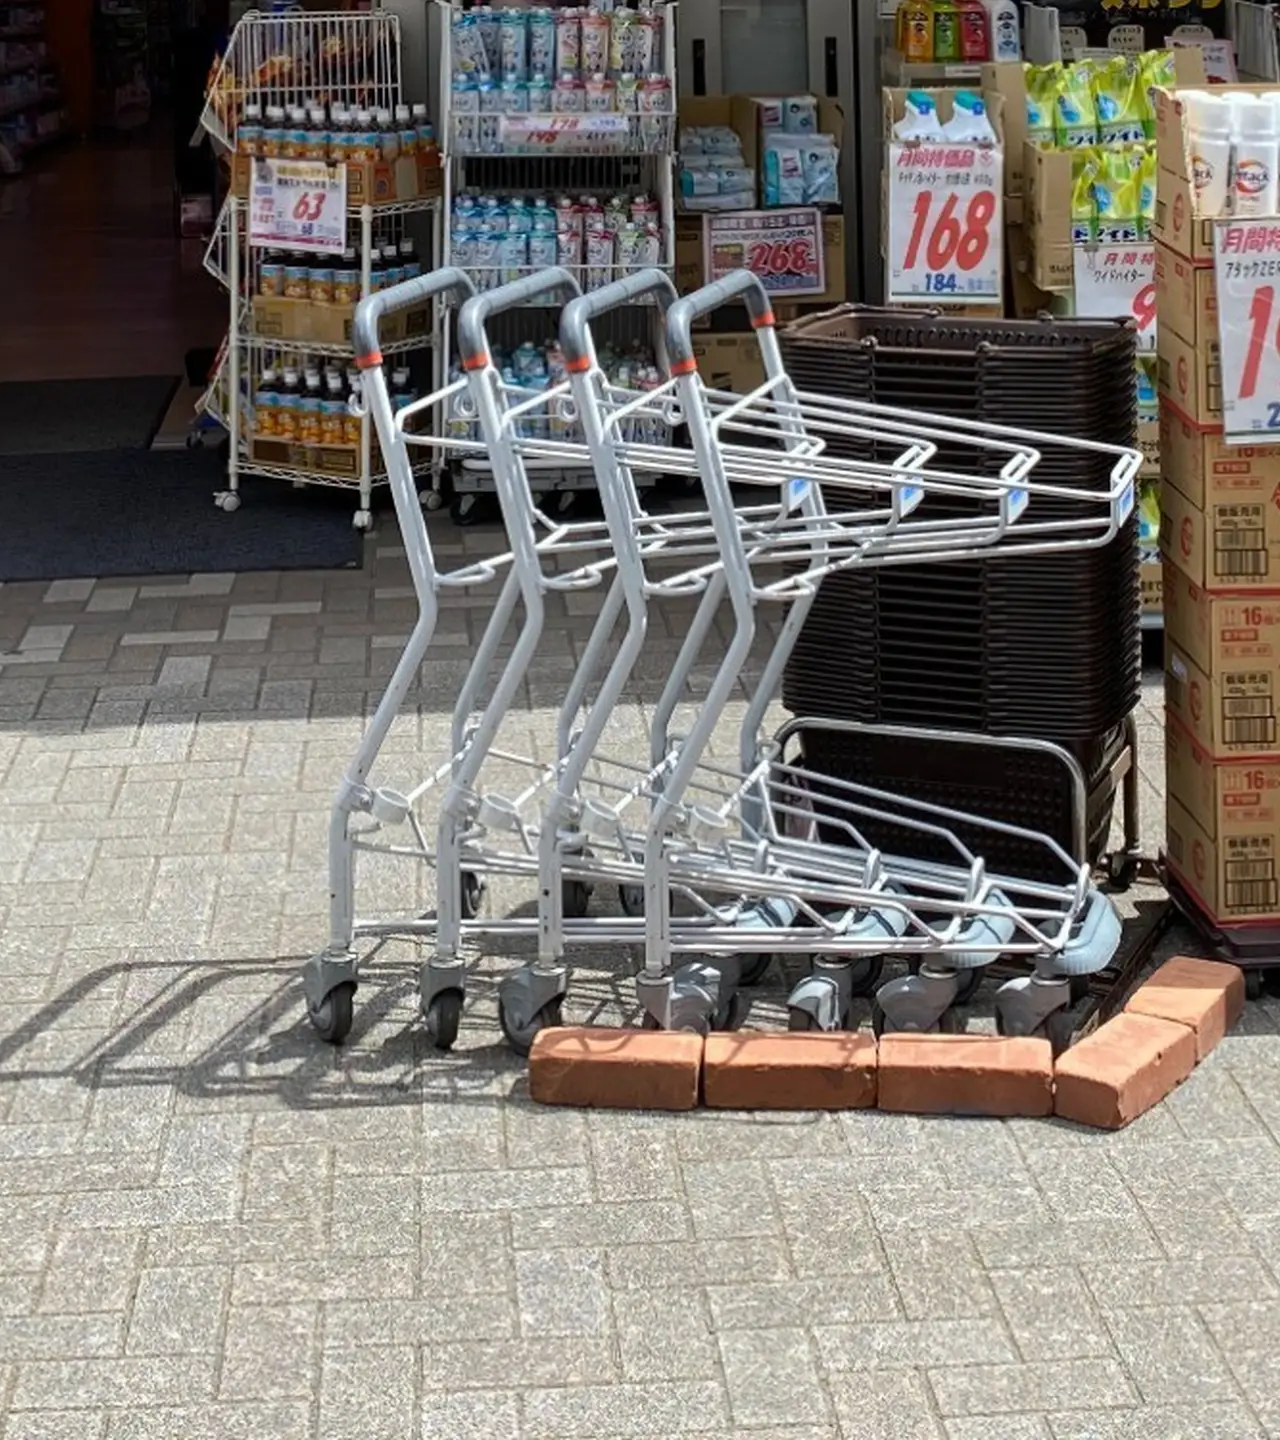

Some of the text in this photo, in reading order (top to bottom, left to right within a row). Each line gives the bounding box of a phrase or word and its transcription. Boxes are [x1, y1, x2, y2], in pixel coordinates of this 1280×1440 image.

[292, 191, 326, 222] 63
[902, 190, 996, 271] 168
[747, 239, 814, 275] 268
[924, 273, 958, 292] 184
